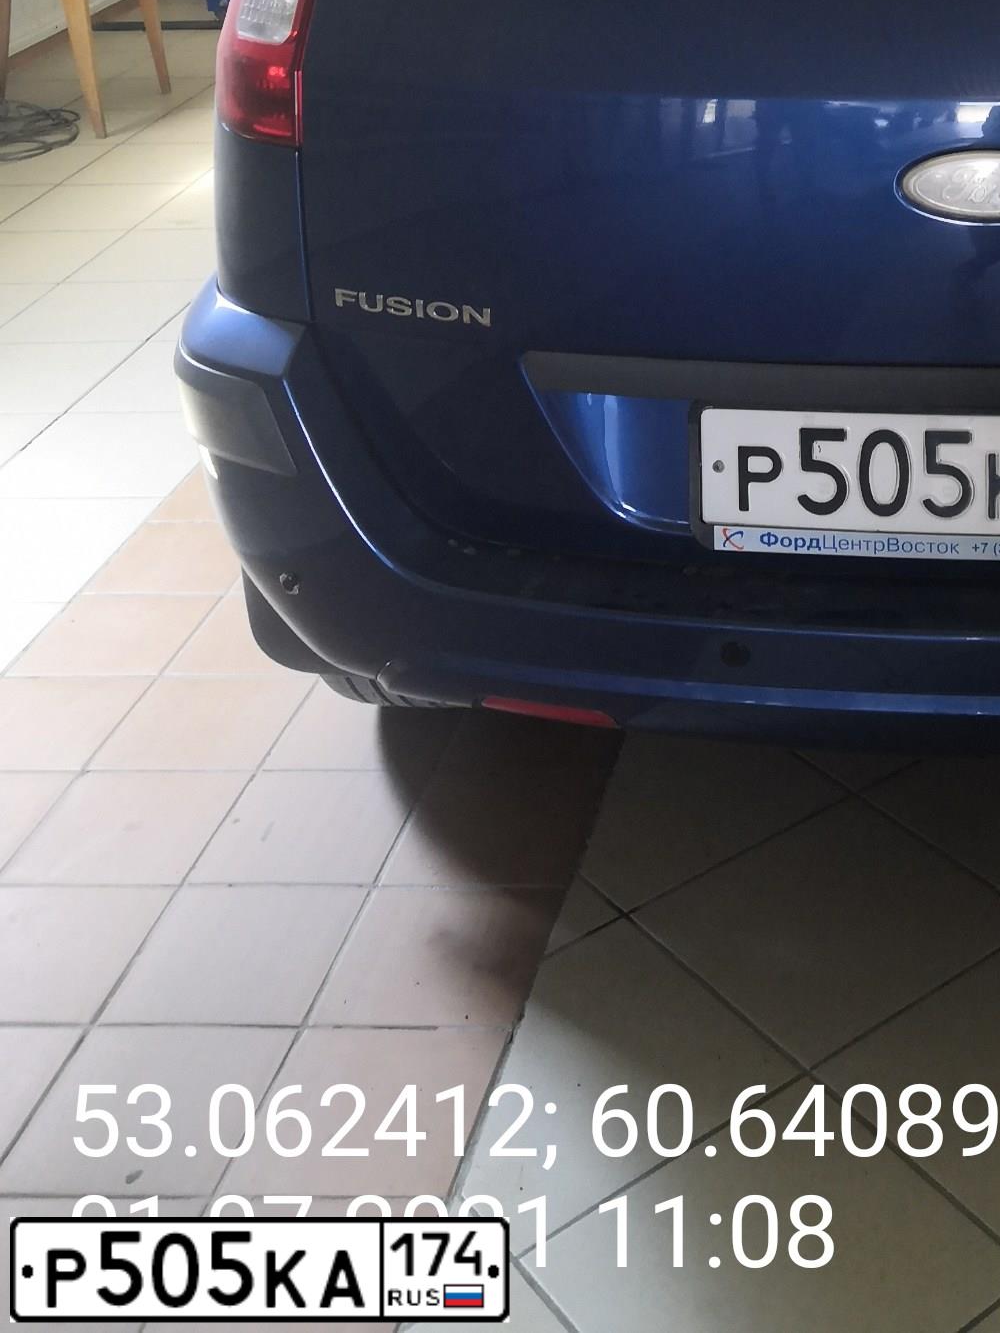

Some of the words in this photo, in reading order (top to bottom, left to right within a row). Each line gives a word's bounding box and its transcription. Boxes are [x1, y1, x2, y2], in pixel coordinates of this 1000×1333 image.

[334, 287, 491, 327] FUSION
[759, 531, 960, 555] ФордЦентрВосток
[971, 542, 988, 554] +7
